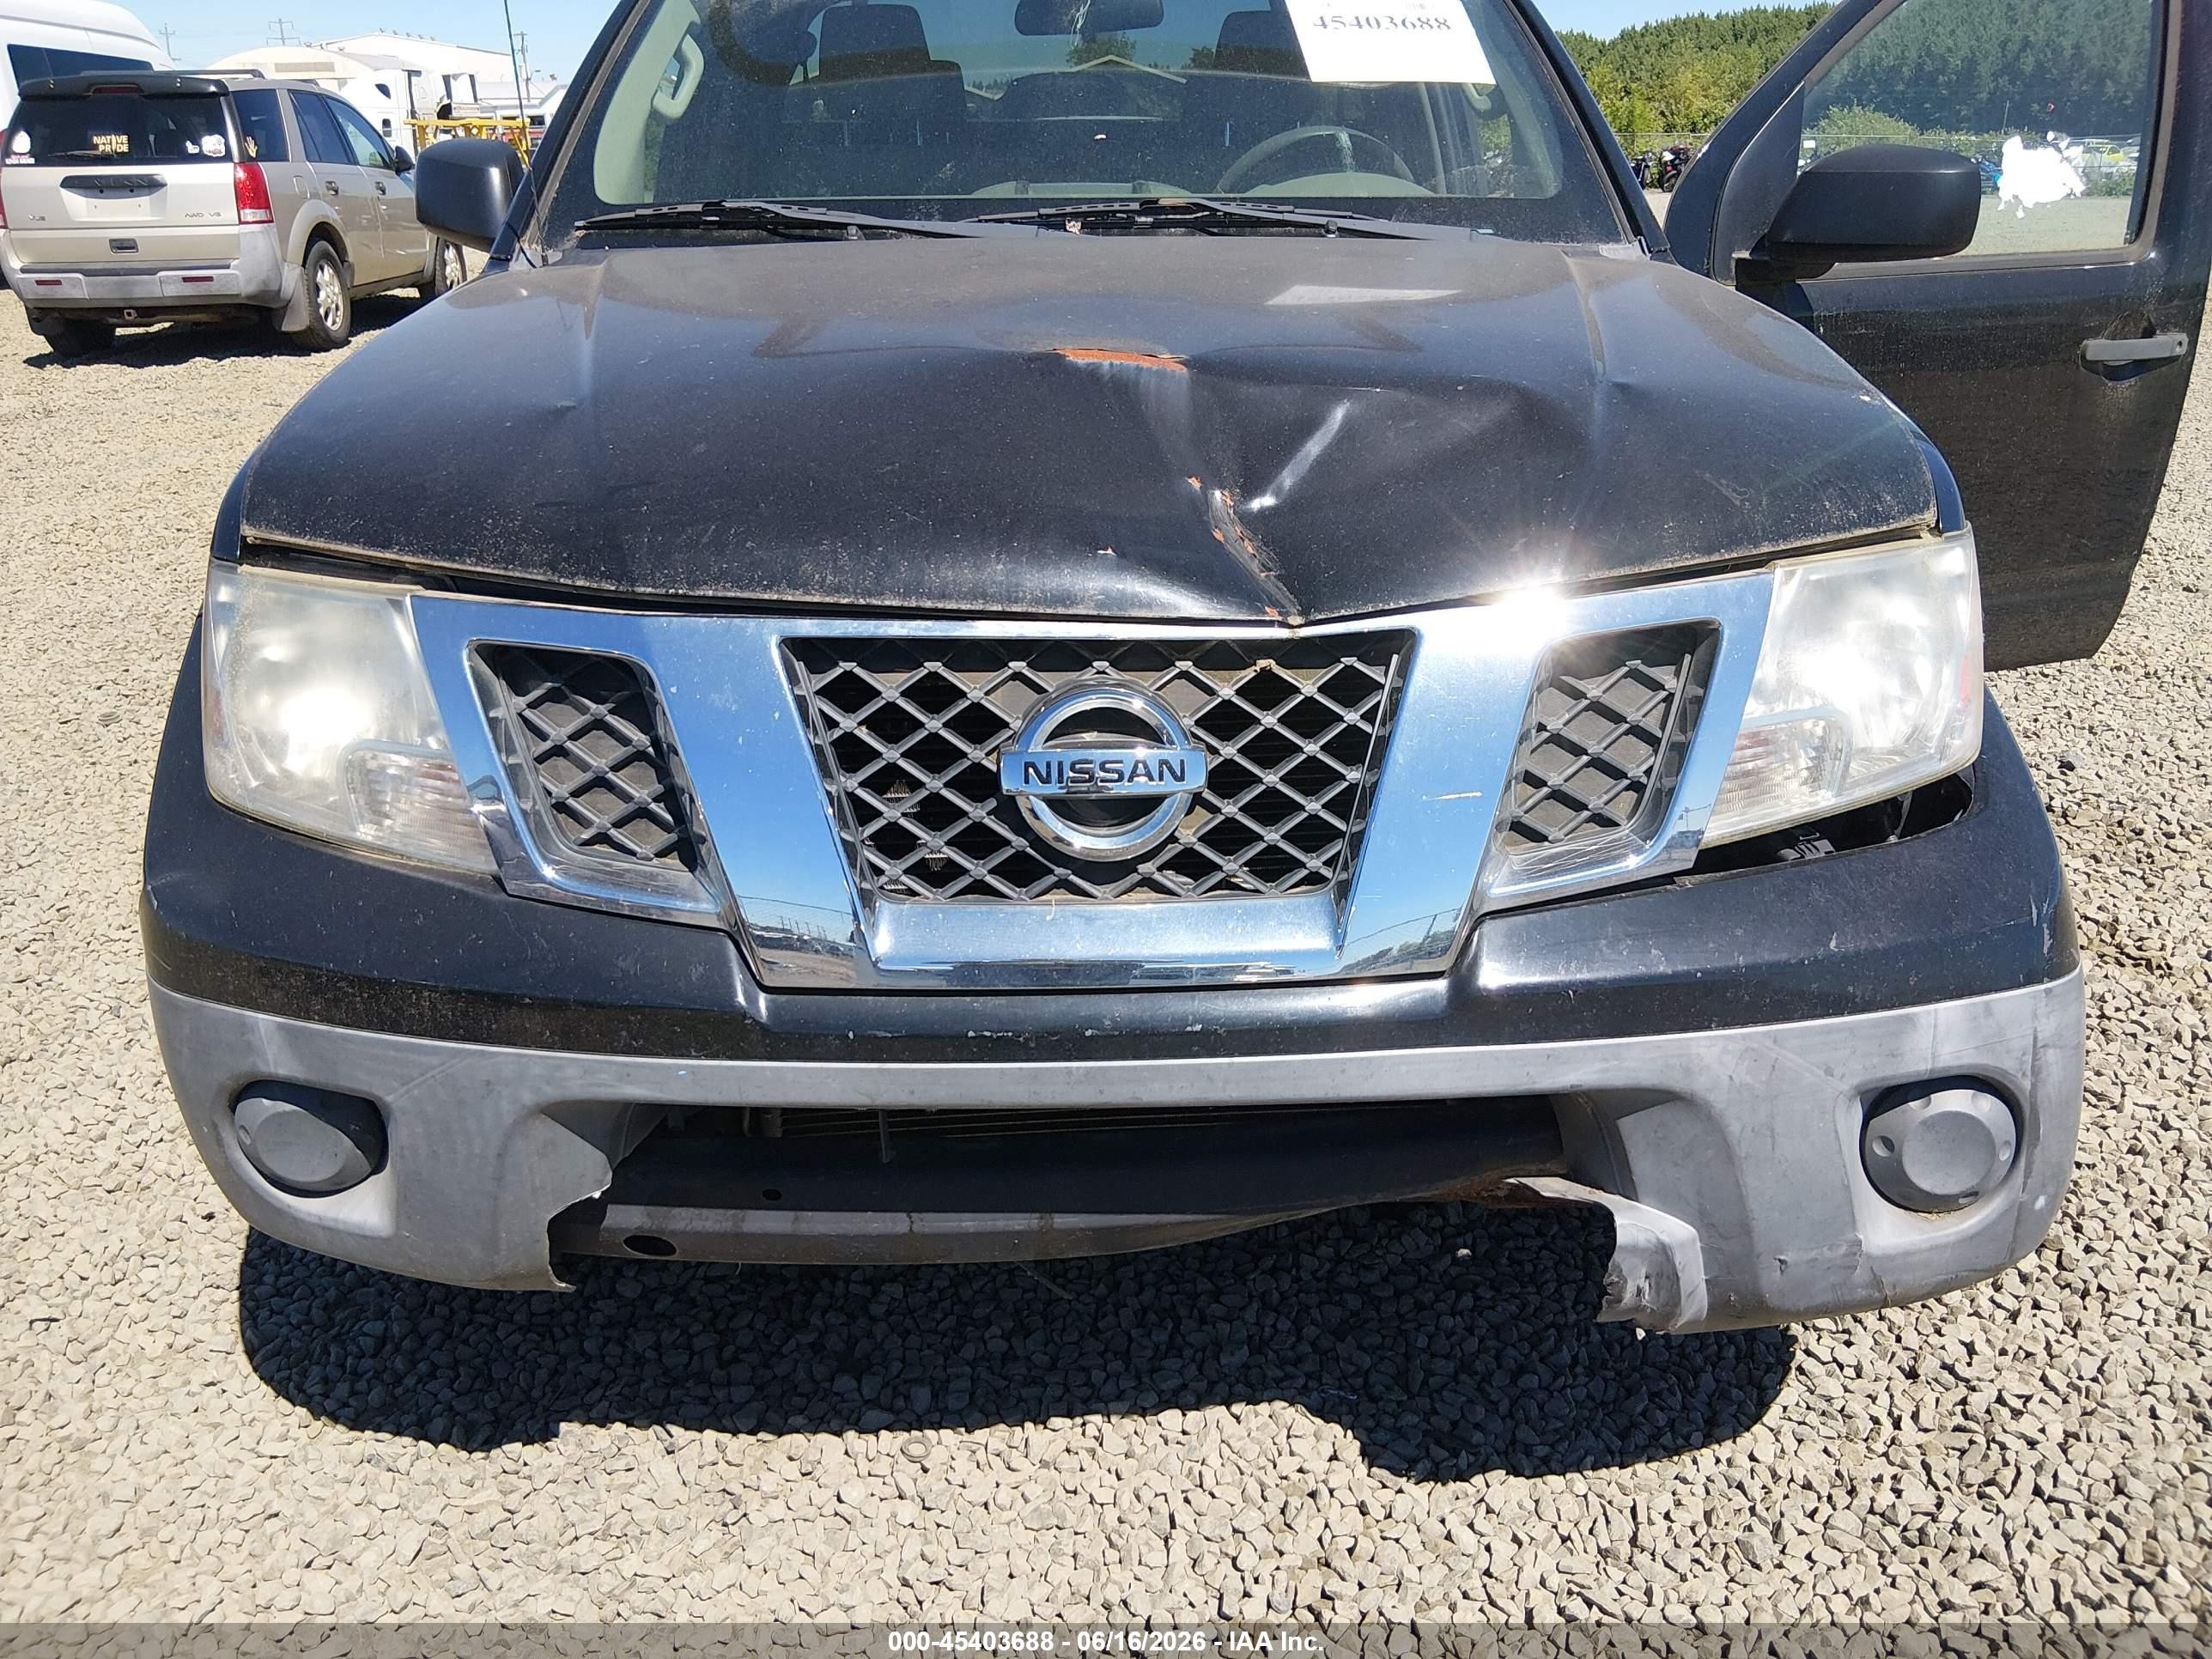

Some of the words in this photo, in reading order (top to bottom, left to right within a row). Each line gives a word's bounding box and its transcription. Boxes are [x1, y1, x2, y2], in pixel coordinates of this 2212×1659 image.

[1313, 15, 1452, 31] 45403688
[93, 134, 129, 144] NATIVE
[99, 143, 129, 153] PRIDE
[1023, 757, 1187, 786] NISSAN
